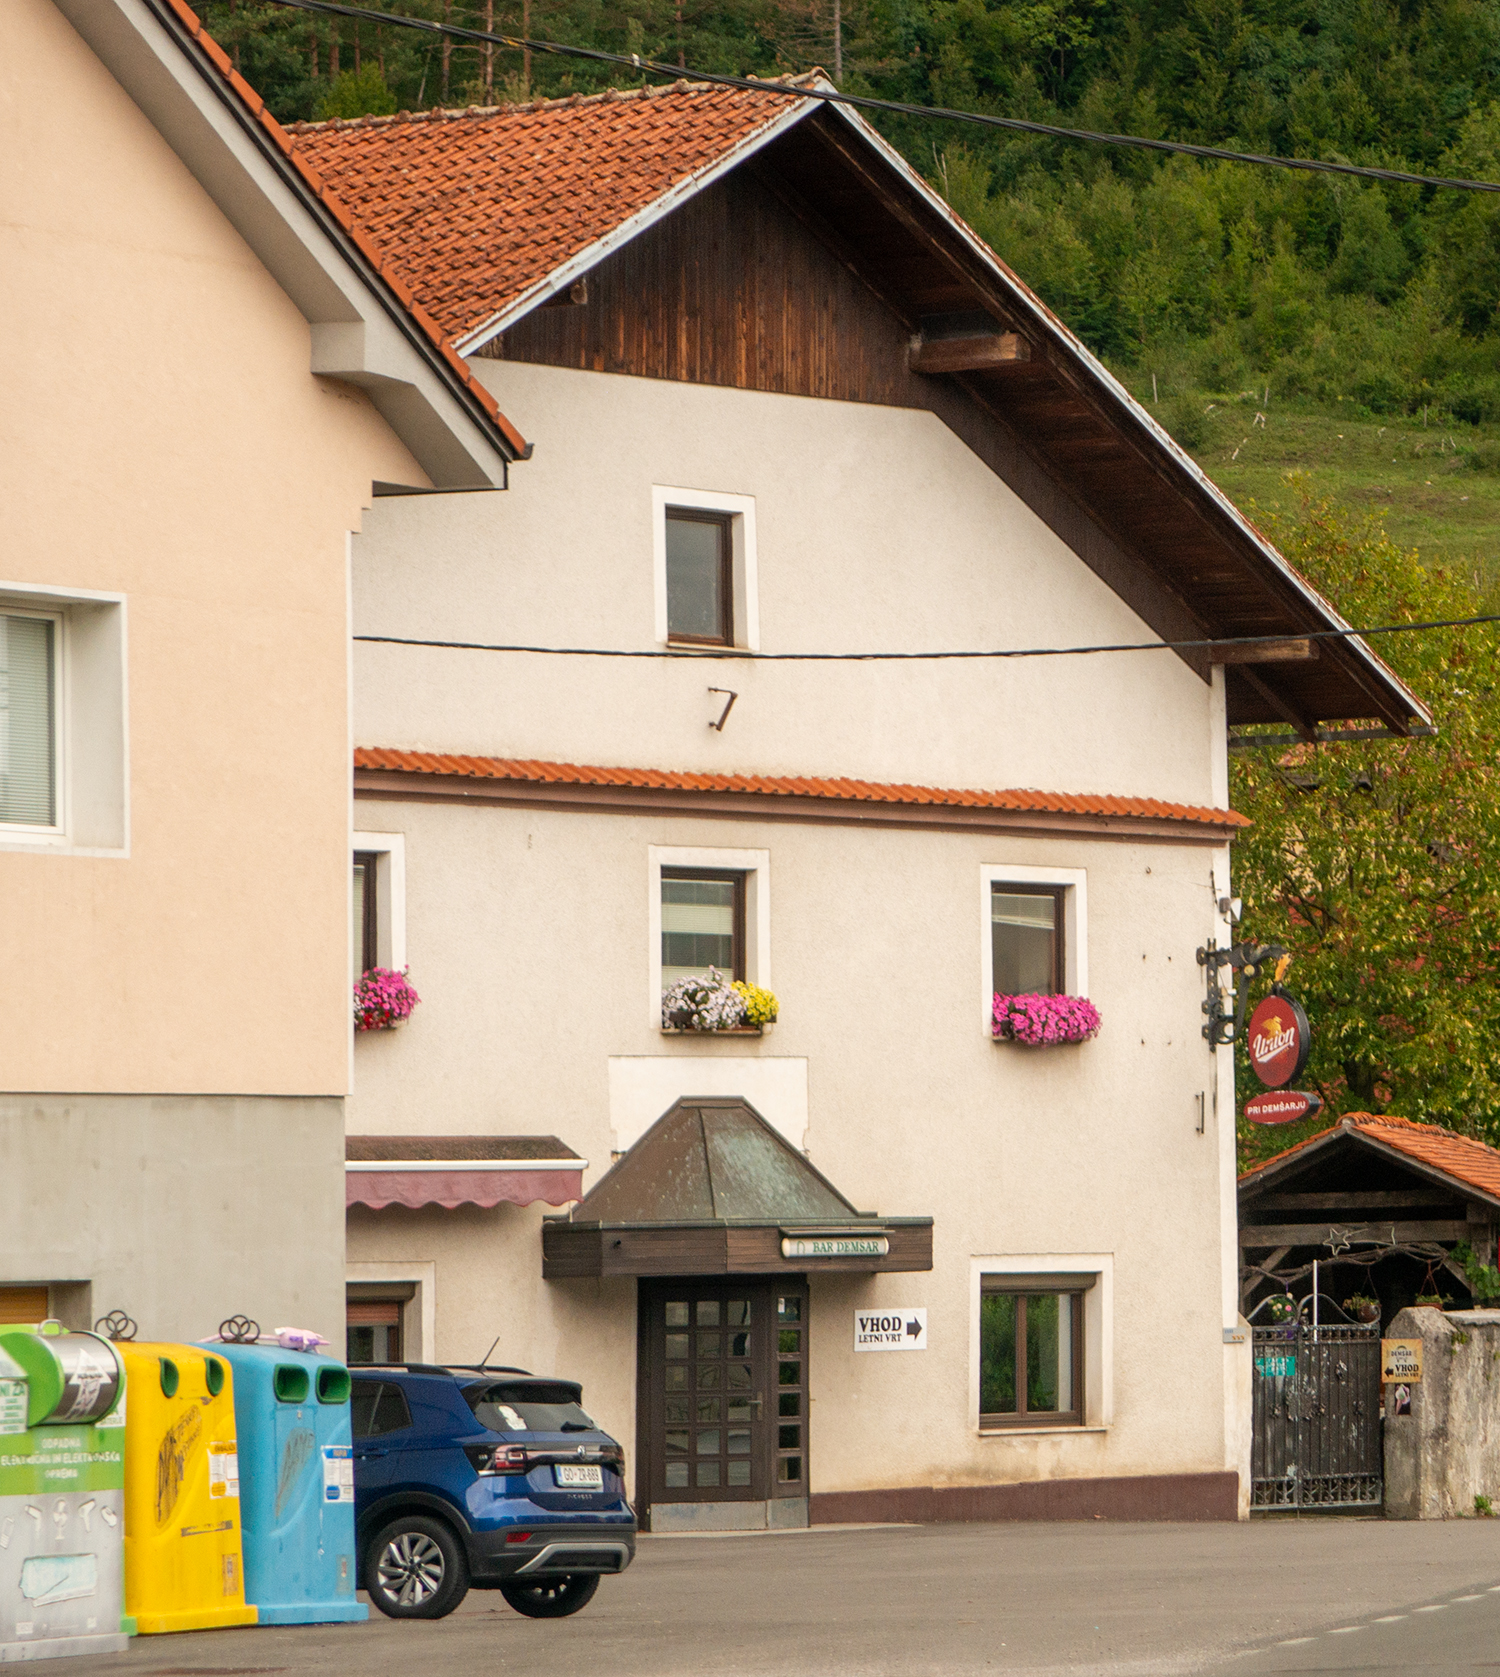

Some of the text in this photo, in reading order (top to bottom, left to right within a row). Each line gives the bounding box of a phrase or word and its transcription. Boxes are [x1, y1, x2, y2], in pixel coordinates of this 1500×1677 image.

[1253, 1027, 1295, 1062] Union
[1247, 1101, 1306, 1115] PRI DEMŠARJU
[813, 1241, 834, 1253] BAR
[859, 1317, 902, 1332] VHOD
[859, 1333, 902, 1343] LETNI VRT
[1395, 1364, 1419, 1372] VHOD
[53, 1453, 61, 1464] IN
